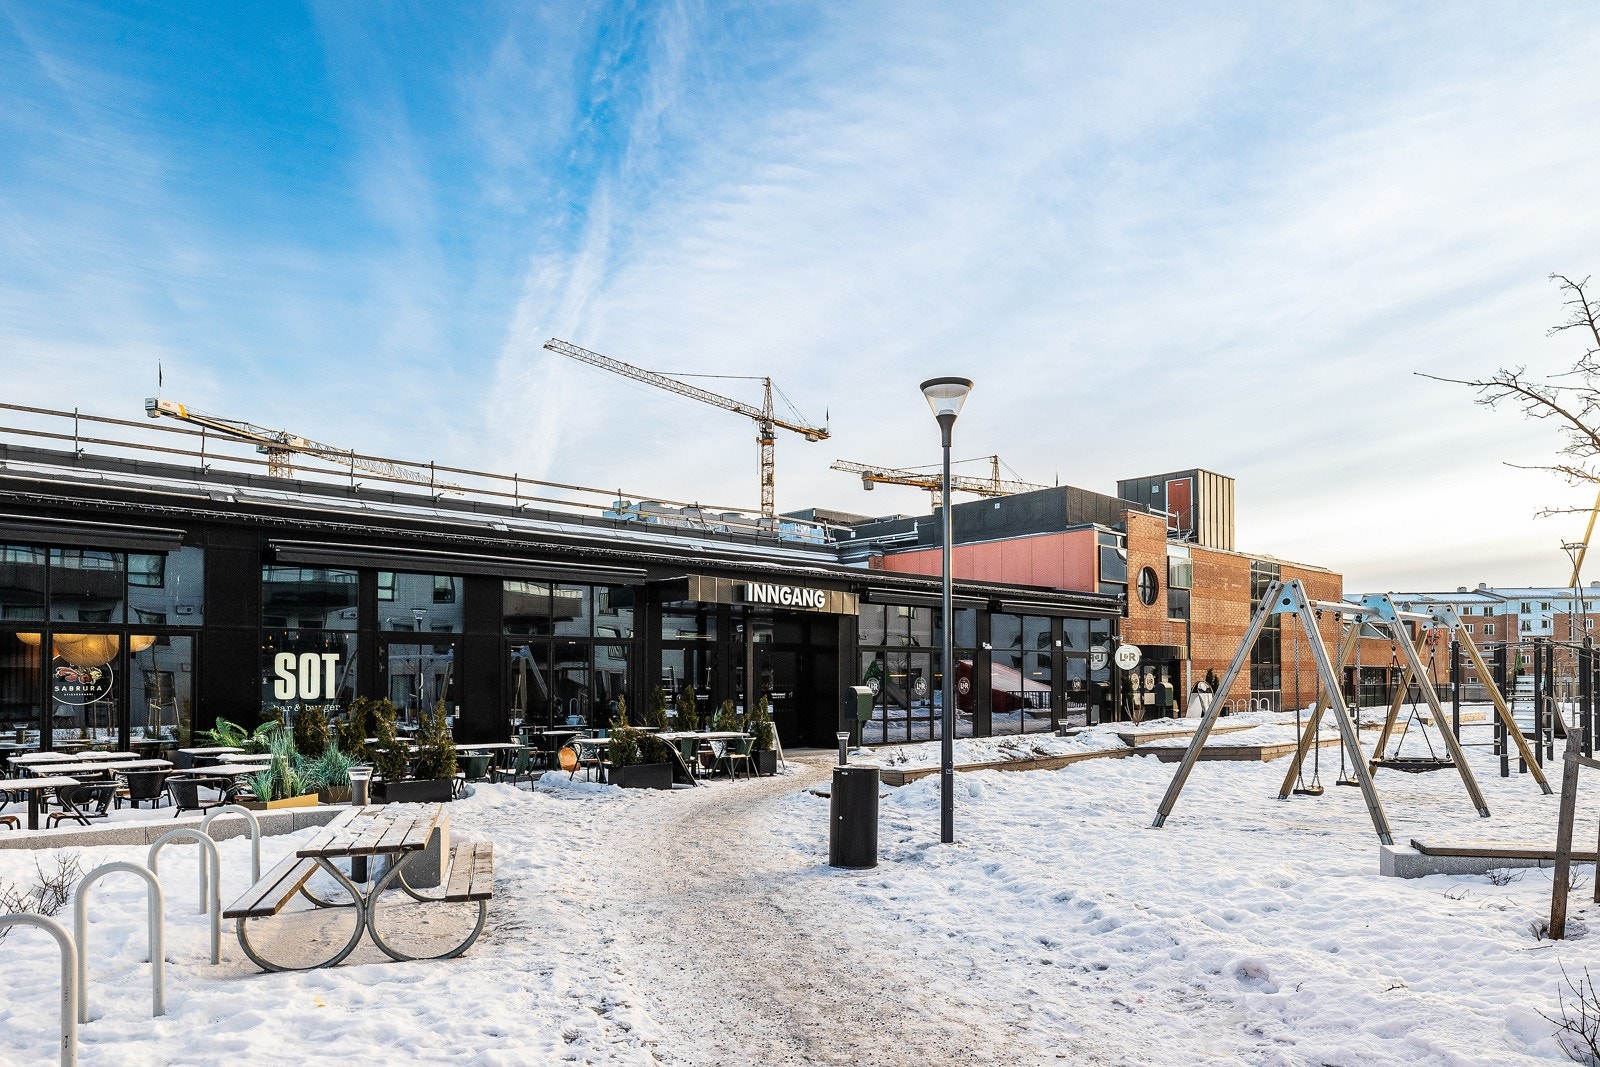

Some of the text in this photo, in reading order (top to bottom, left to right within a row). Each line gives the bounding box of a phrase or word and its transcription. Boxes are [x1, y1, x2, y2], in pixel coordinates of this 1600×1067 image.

[747, 582, 826, 608] INNGANG
[274, 652, 340, 700] SOT
[293, 703, 301, 712] &
